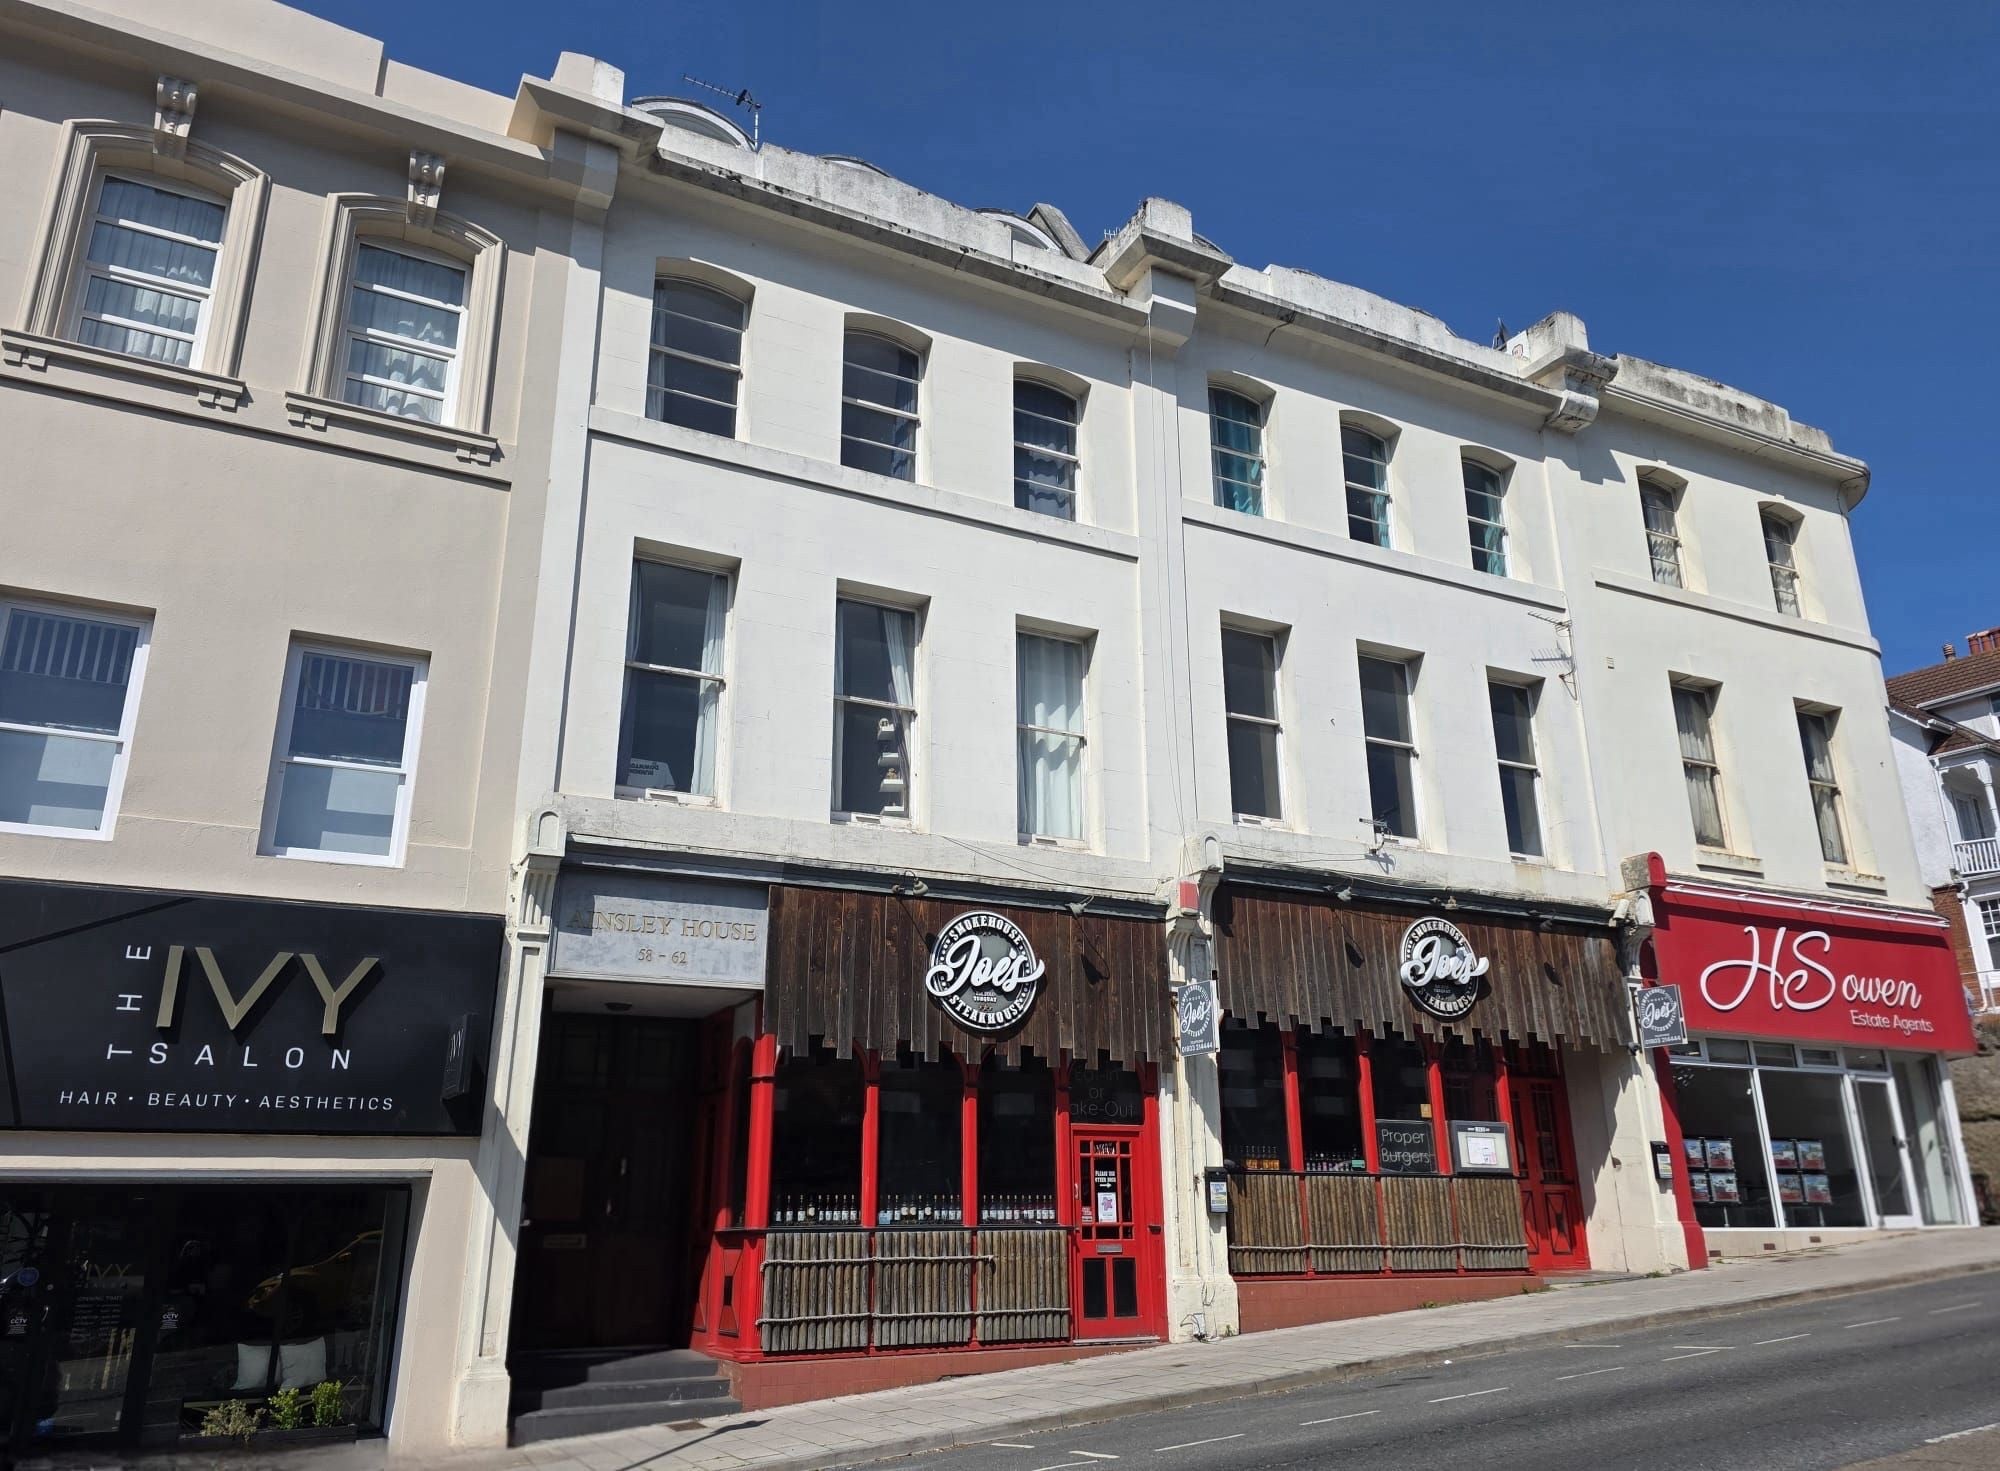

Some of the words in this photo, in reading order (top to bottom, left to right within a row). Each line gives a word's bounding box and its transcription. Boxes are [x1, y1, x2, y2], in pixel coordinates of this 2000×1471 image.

[567, 910, 674, 936] AINSLEY
[680, 918, 757, 942] HOUSE
[949, 915, 1023, 946] SMOKEHOUSE
[1411, 921, 1468, 946] SMOKEHOUSE
[638, 948, 653, 962] 58
[671, 950, 688, 965] 62
[926, 934, 1046, 997] Joe's
[1400, 936, 1490, 987] Joe's
[106, 944, 152, 1060] THE
[156, 944, 380, 1035] IVY
[1418, 987, 1474, 1012] STEAKHOUSE
[1842, 974, 1923, 1009] owen
[949, 994, 1024, 1025] STEAKHOUSE
[1850, 1009, 1891, 1030] Estate
[1893, 1014, 1934, 1036] Agents
[149, 1042, 350, 1070] SALON
[60, 1090, 118, 1106] HAIR
[148, 1092, 236, 1109] BEAUTY
[259, 1095, 394, 1112] AESTHETICS
[1070, 1100, 1135, 1118] ake-Out
[1381, 1129, 1425, 1148] Proper
[1381, 1148, 1431, 1167] Burgers
